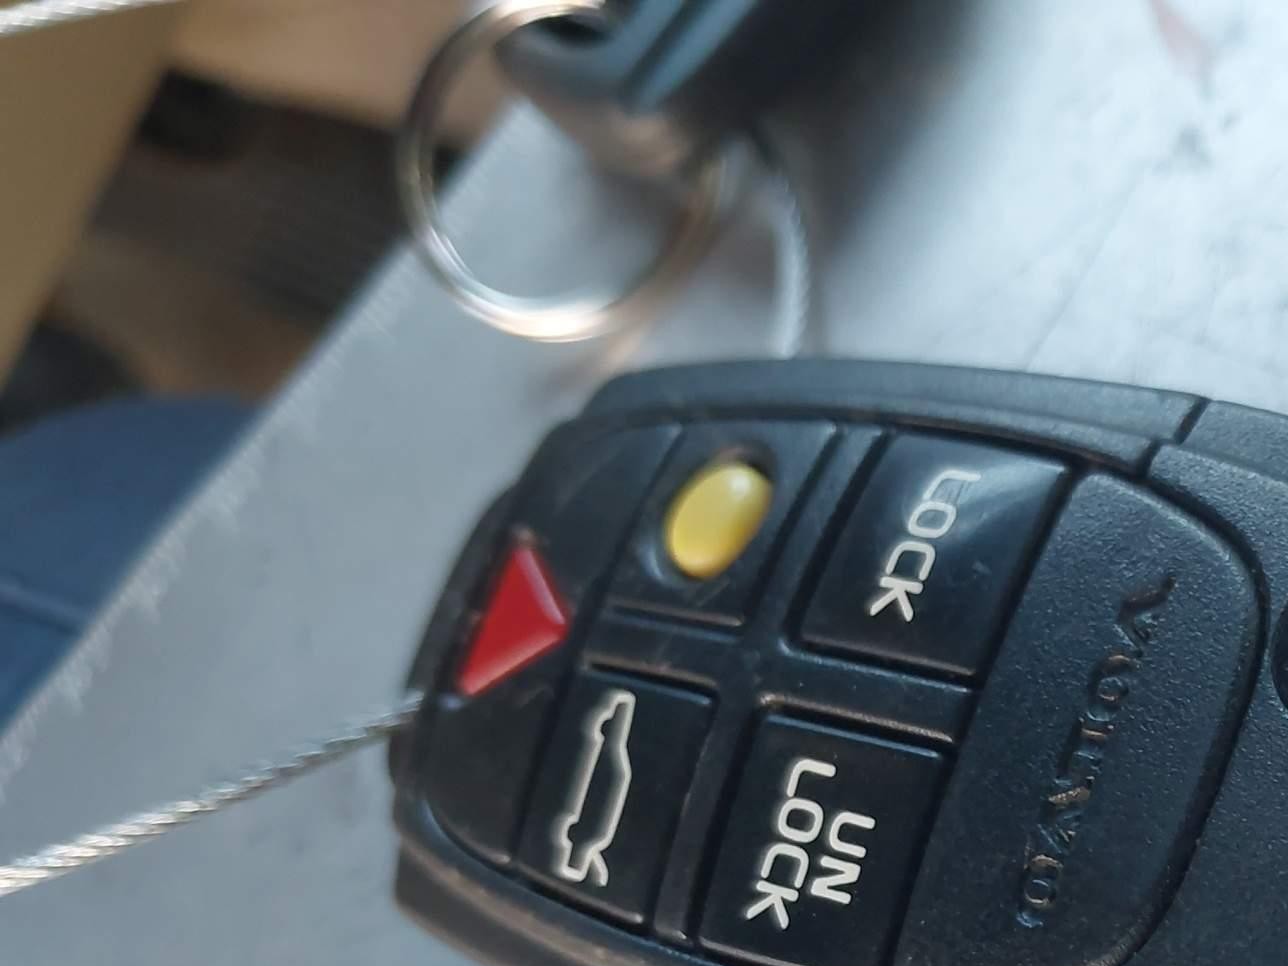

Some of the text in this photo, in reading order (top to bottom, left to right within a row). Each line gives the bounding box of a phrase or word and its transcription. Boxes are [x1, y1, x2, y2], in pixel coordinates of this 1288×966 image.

[869, 469, 982, 622] LOCK
[1014, 572, 1177, 929] VOLVO
[745, 758, 837, 930] LOCK
[810, 811, 876, 905] UN
